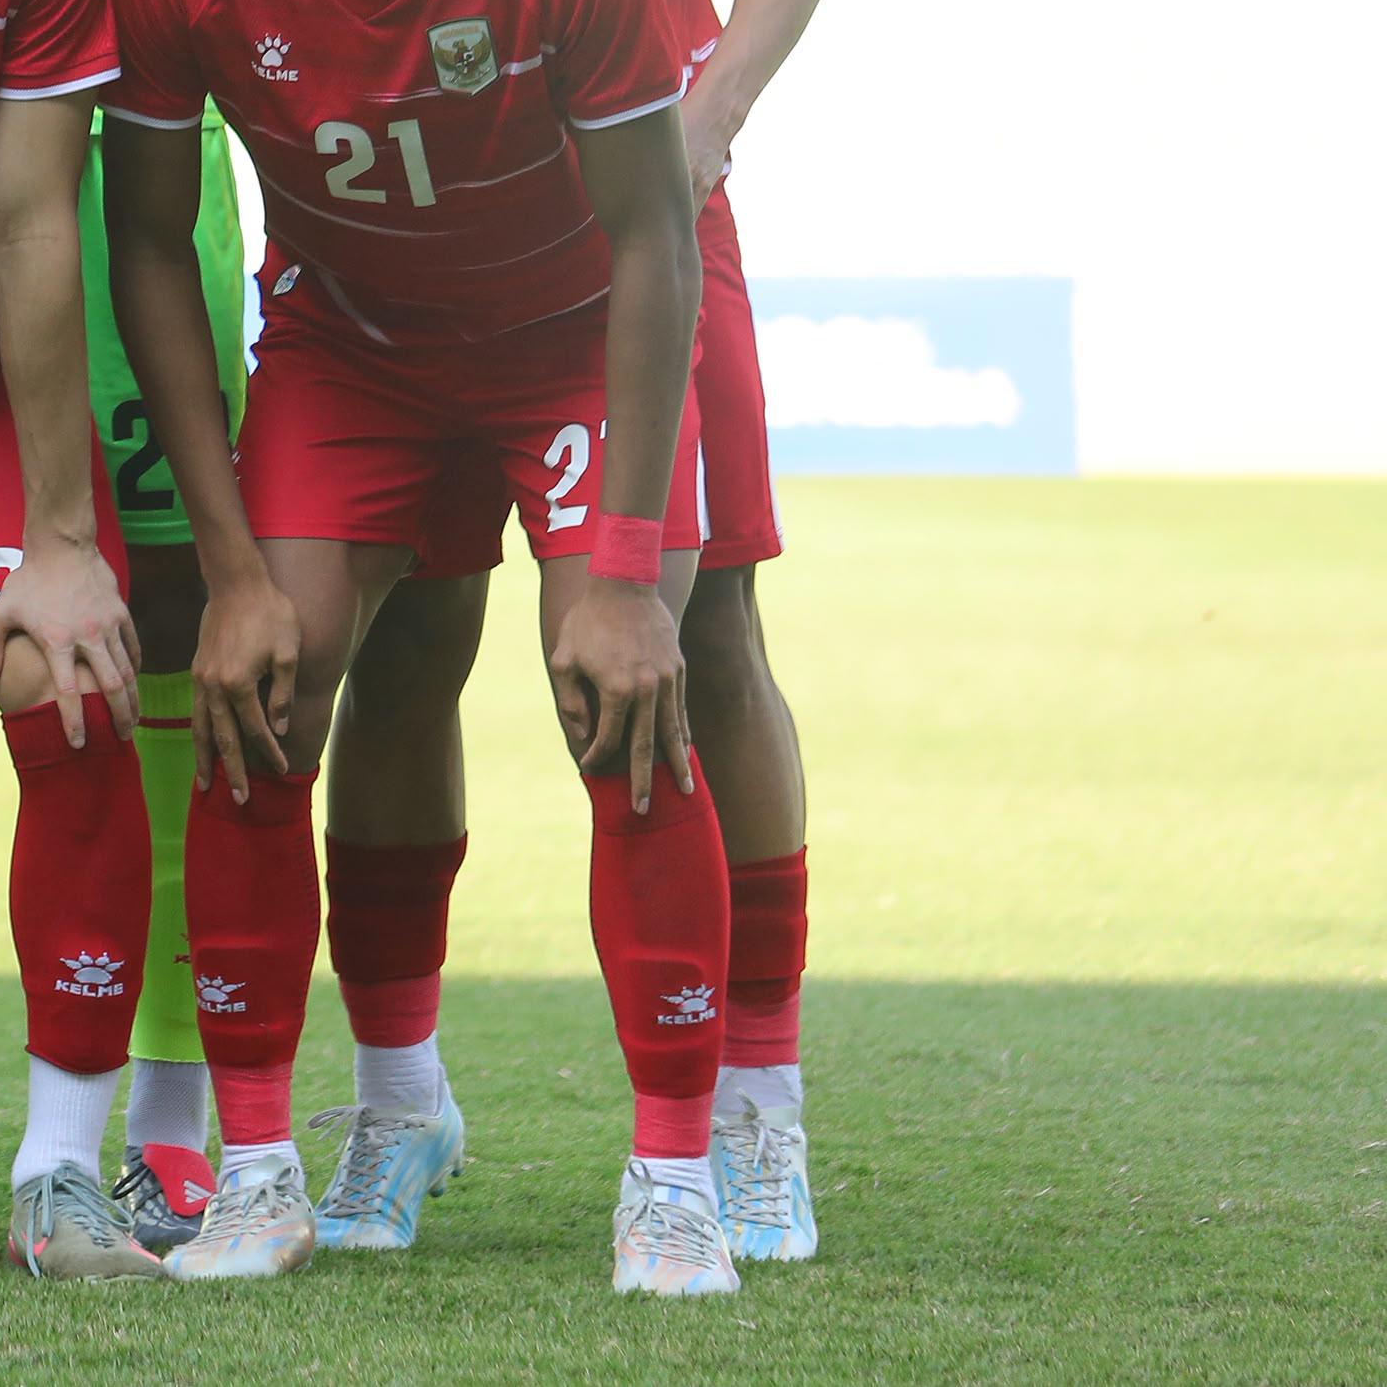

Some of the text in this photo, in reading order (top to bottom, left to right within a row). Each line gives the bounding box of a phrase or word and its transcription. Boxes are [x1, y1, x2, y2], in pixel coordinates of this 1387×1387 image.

[314, 118, 436, 208] 21
[54, 980, 123, 998] KELME
[657, 1007, 716, 1025] KELME
